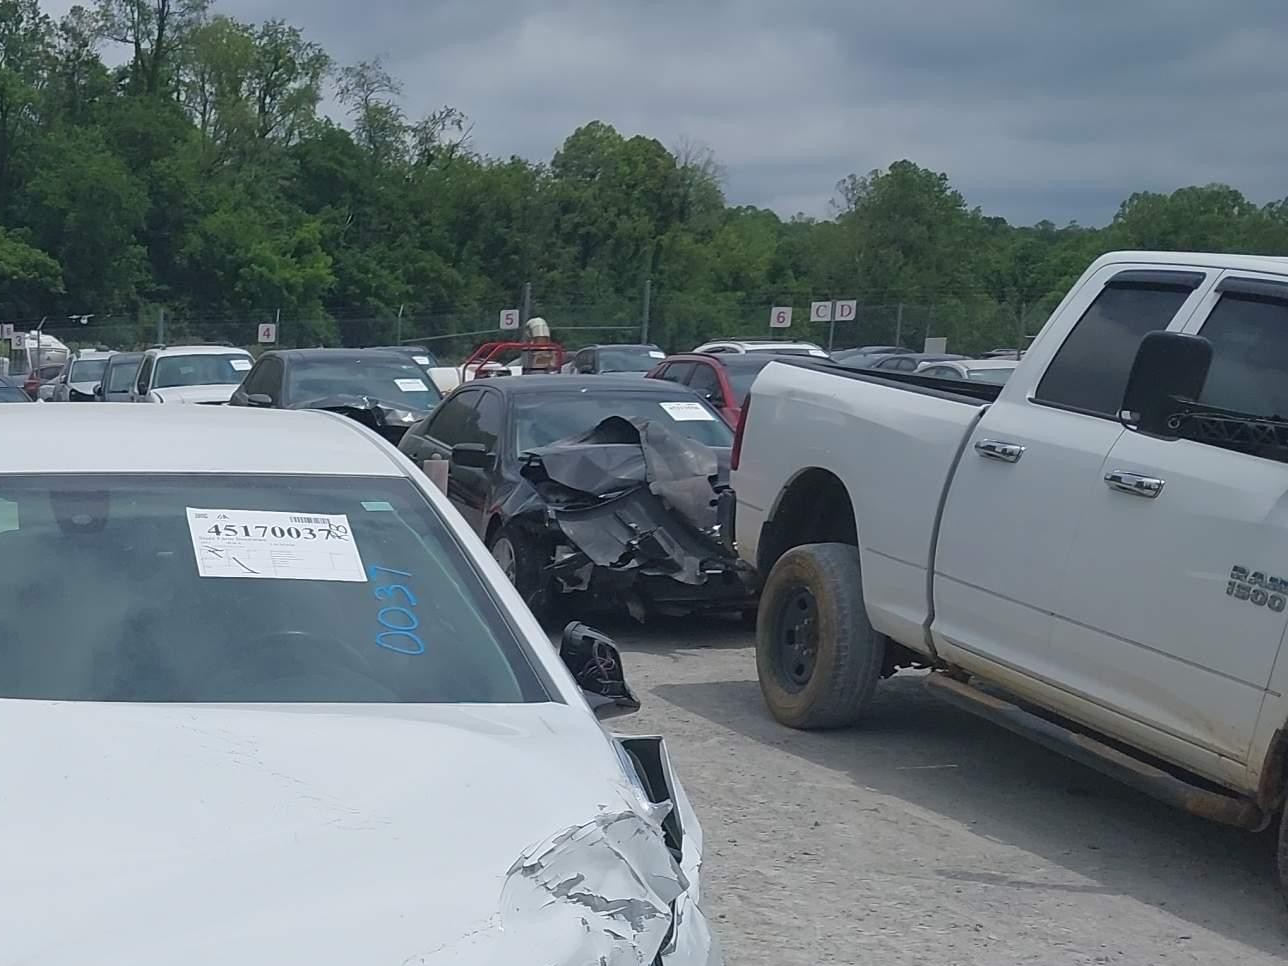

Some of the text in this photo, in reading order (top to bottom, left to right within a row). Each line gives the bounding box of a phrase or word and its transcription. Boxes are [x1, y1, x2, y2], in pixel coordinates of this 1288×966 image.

[776, 311, 786, 323] 6
[815, 304, 827, 318] C
[840, 304, 852, 317] D
[505, 313, 514, 326] 5
[263, 328, 272, 340] 4
[15, 335, 23, 347] 3
[207, 523, 331, 540] 45170037
[1226, 581, 1287, 613] 1500
[368, 565, 425, 655] 0037
